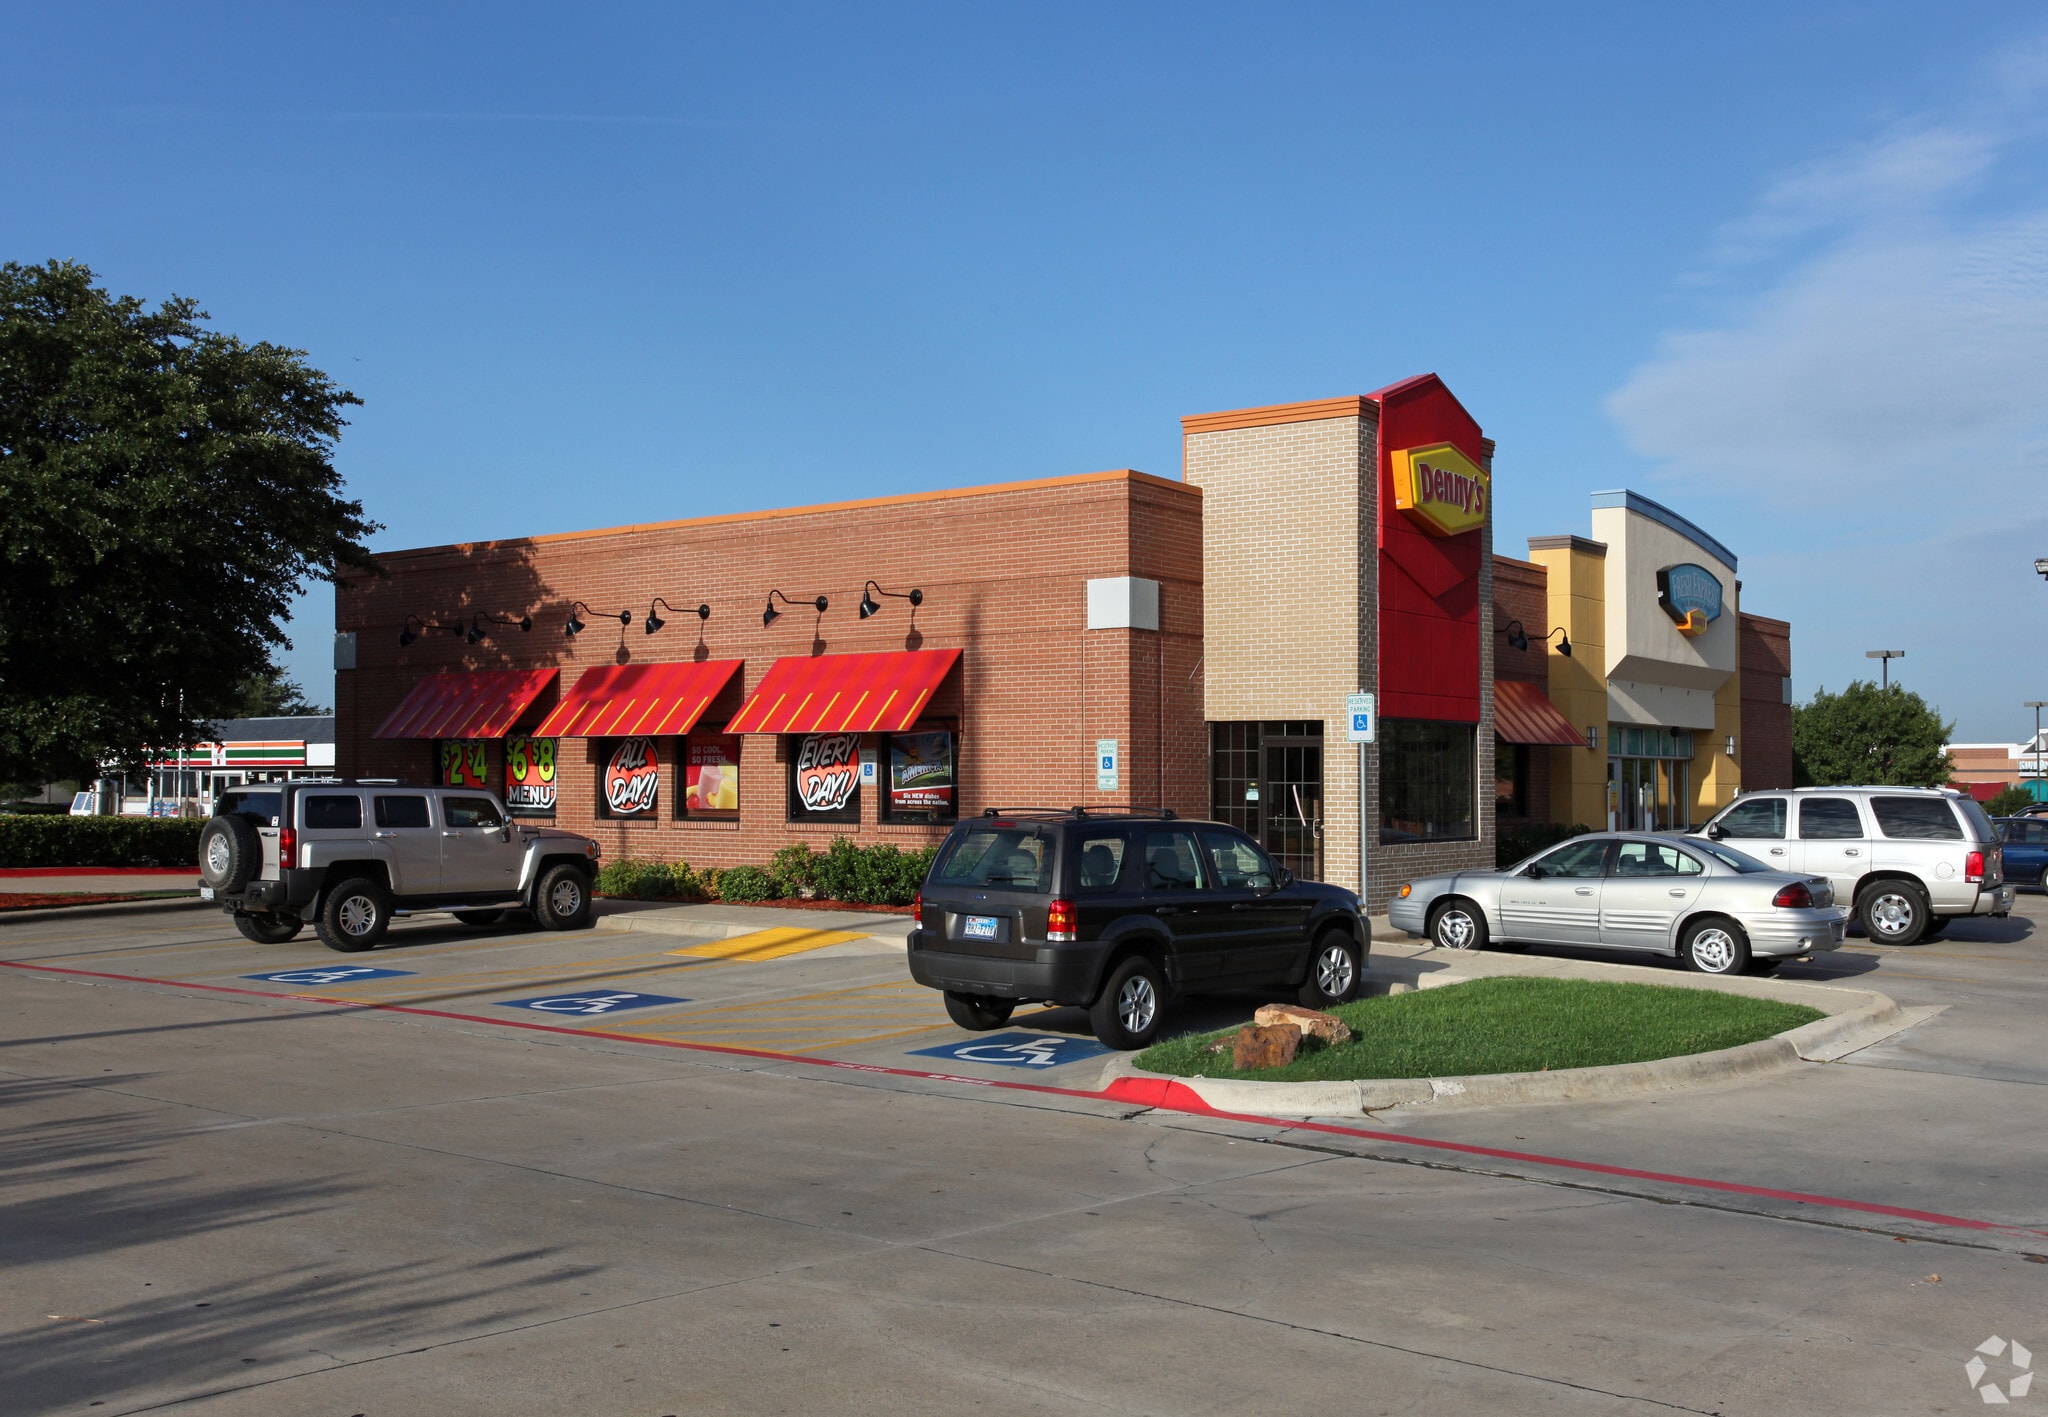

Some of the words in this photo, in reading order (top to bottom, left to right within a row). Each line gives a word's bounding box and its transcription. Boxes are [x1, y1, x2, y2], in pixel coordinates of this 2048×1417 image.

[1418, 462, 1484, 515] Denny's
[1671, 574, 1692, 600] FRESH
[442, 742, 464, 785] $2
[467, 742, 488, 784] $4
[506, 737, 528, 781] $6
[532, 737, 555, 782] $8
[616, 739, 648, 771] ALL
[691, 756, 702, 764] SO
[692, 746, 701, 754] SO
[801, 733, 858, 769] EVERY
[806, 770, 850, 804] DAY!
[901, 759, 944, 785] AMERICA
[508, 785, 551, 803] MENU
[611, 772, 656, 806] DAY!
